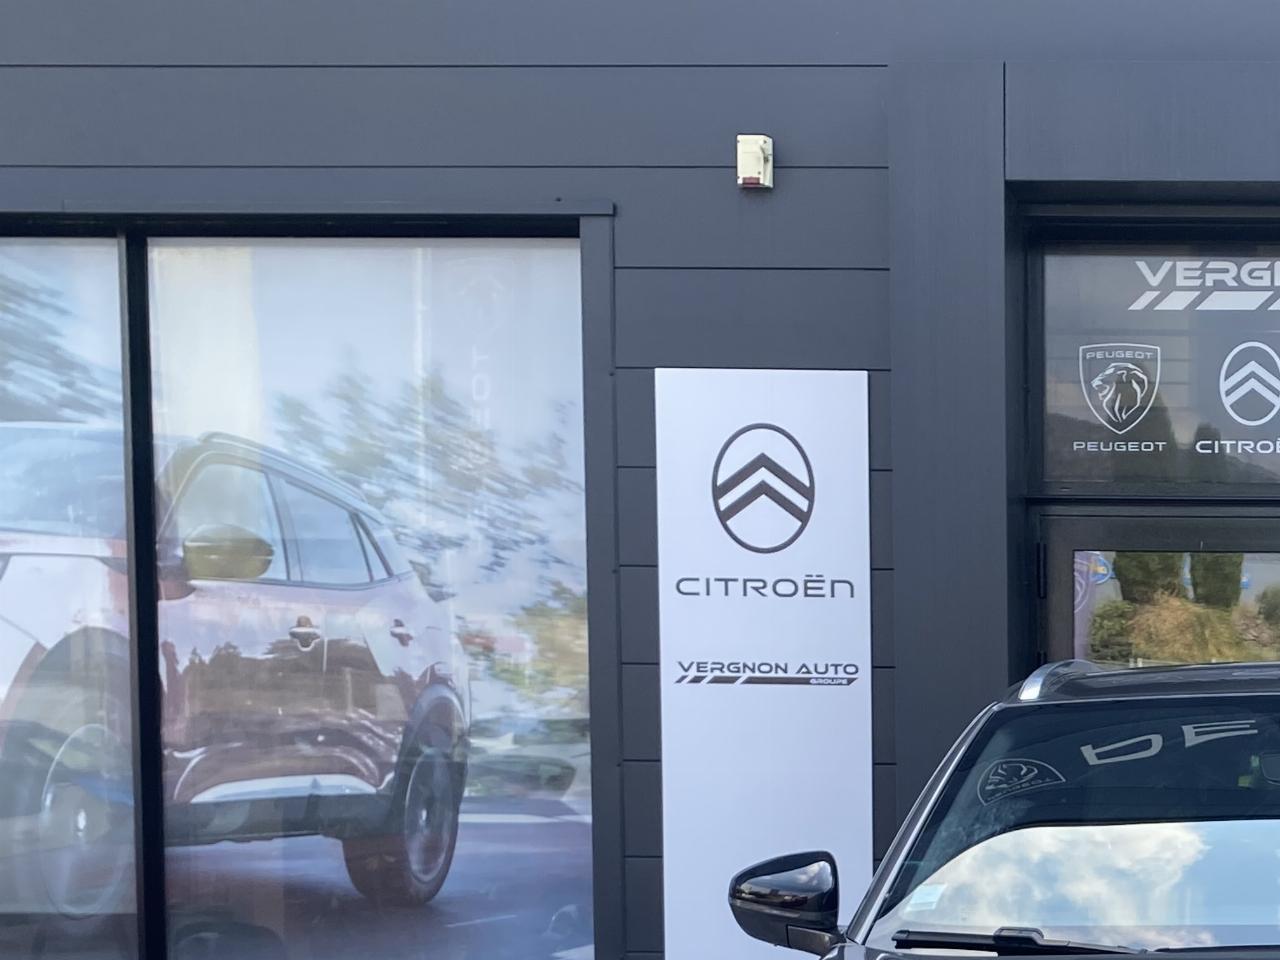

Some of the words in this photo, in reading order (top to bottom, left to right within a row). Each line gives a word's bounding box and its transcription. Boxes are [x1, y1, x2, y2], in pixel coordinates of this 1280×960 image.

[1085, 350, 1154, 361] PEUGEOT
[1072, 441, 1167, 453] PEUGEOT
[677, 661, 788, 674] VERGNON
[795, 662, 860, 676] AUTO
